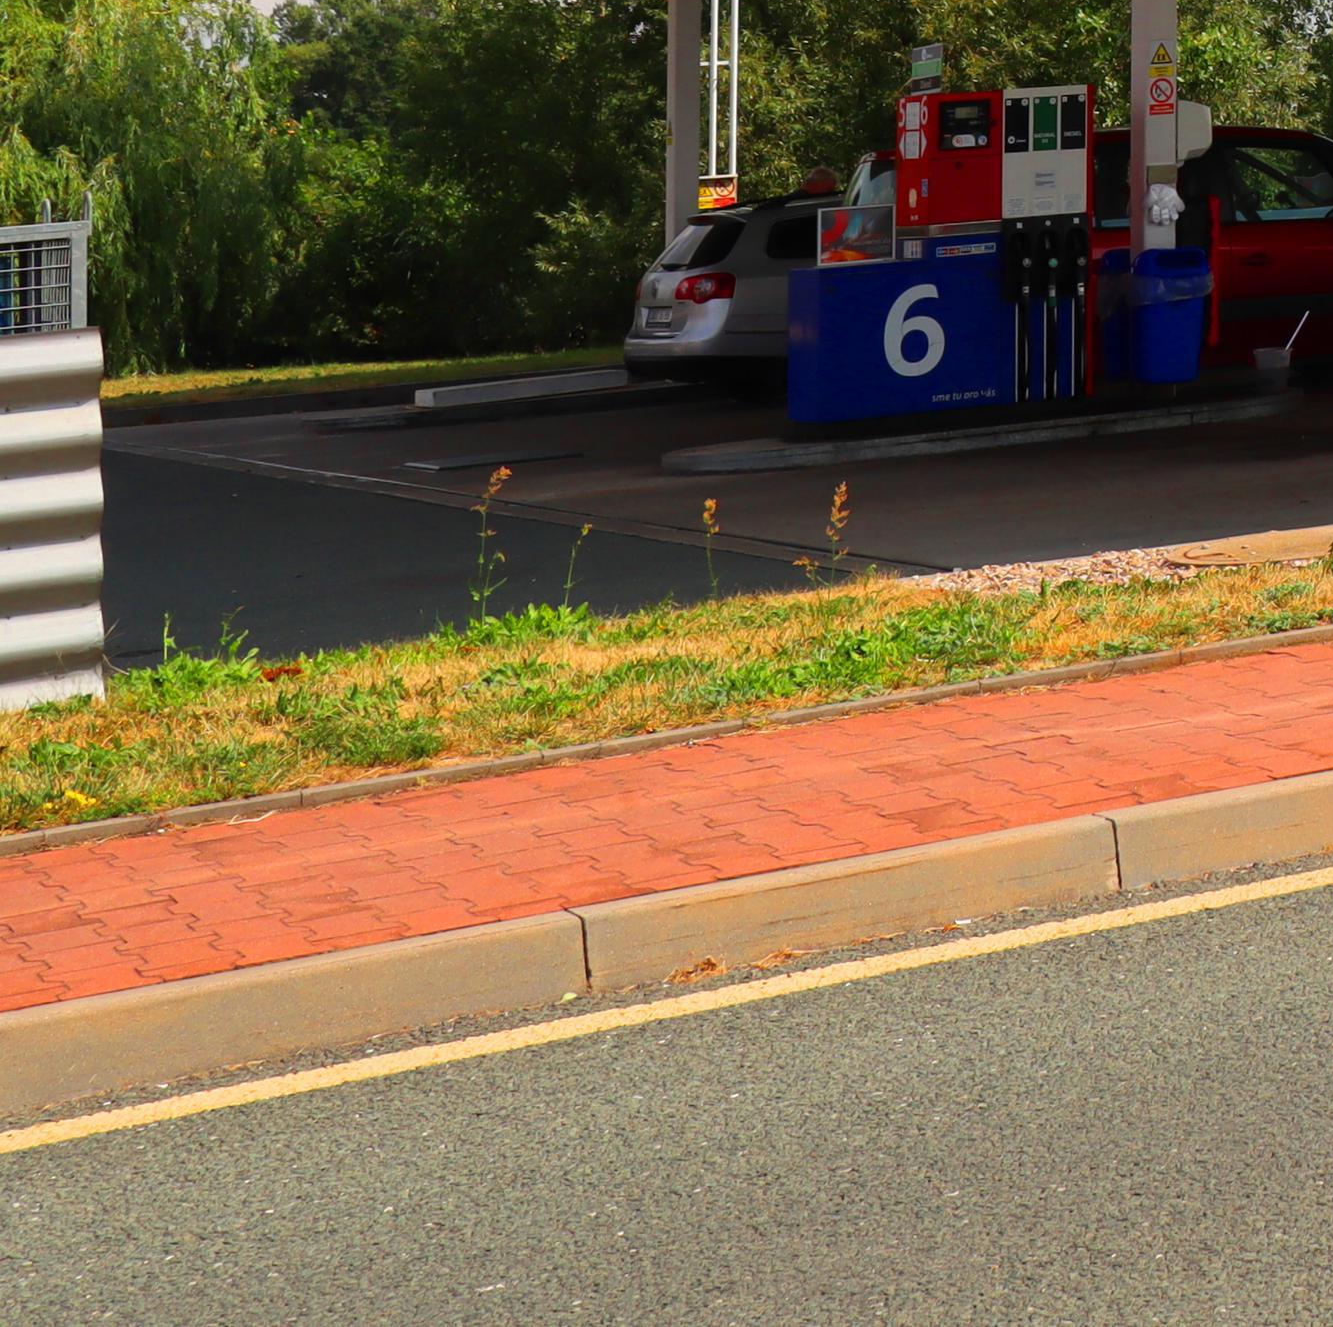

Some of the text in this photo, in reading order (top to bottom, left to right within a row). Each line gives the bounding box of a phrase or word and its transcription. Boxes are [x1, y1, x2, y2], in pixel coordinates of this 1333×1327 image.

[897, 98, 906, 127] 5
[920, 95, 928, 125] 6
[884, 283, 945, 377] 6
